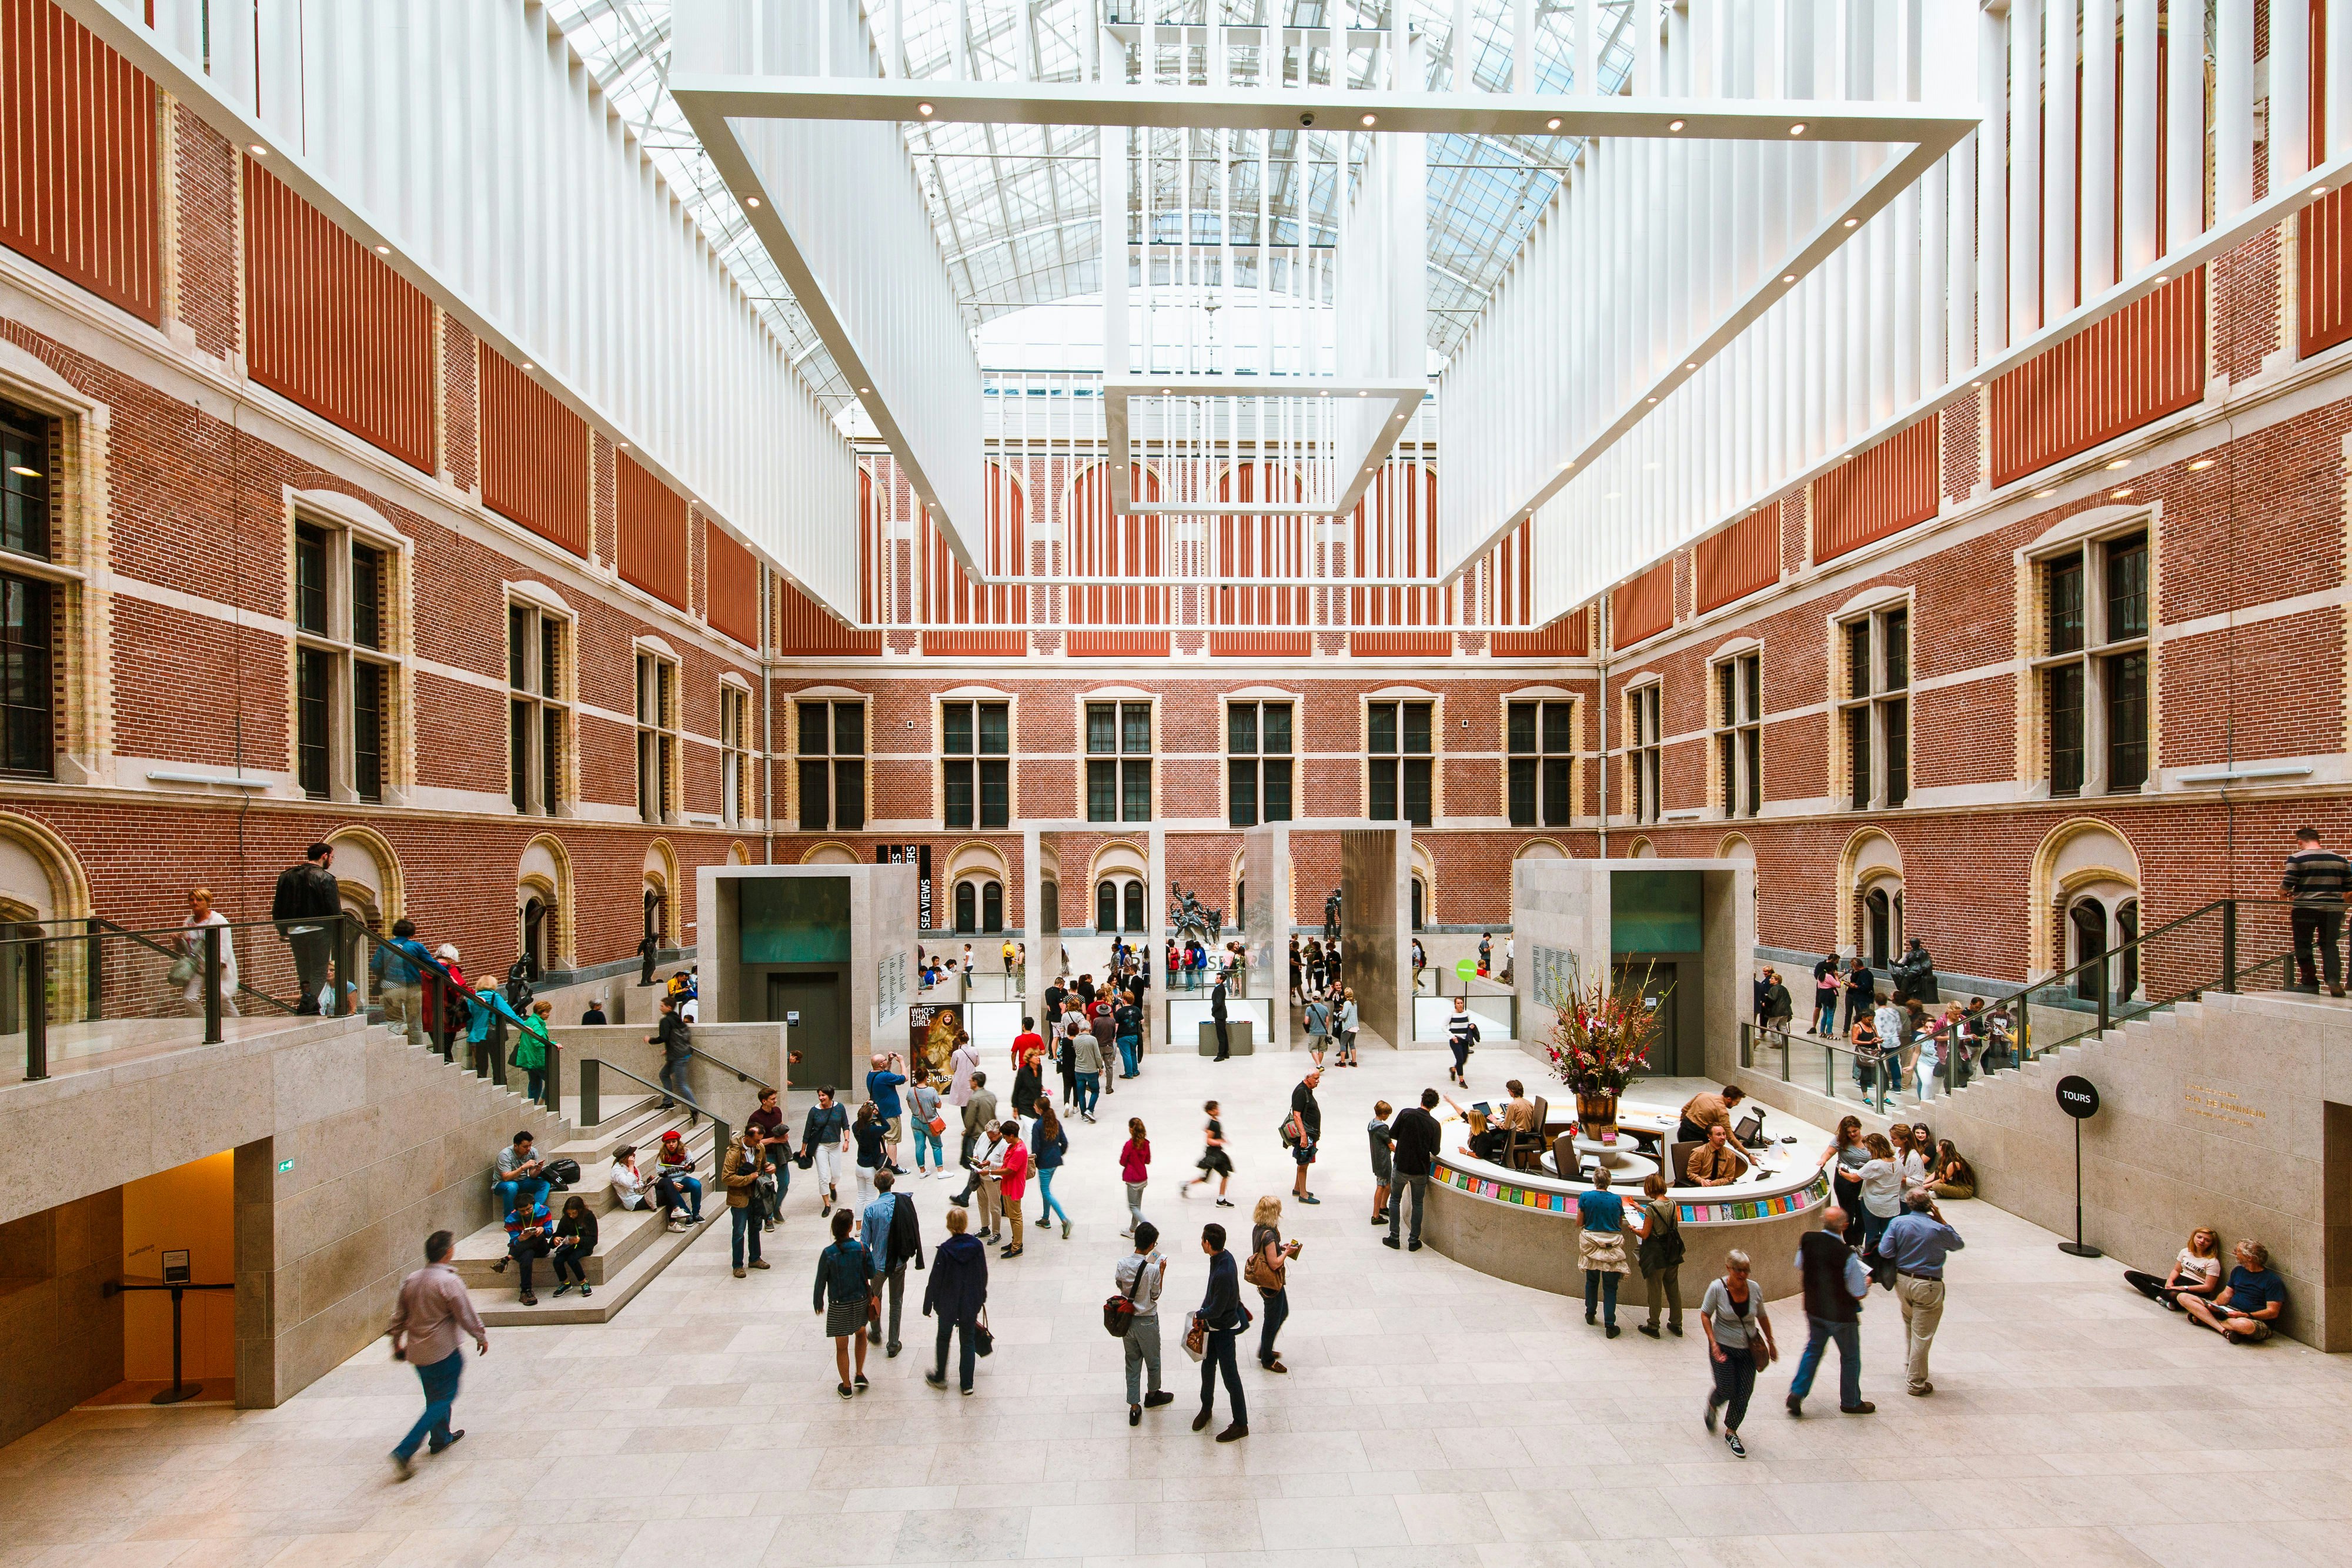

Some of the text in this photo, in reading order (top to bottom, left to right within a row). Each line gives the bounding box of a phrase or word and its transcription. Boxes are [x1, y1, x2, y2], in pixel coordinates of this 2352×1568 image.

[921, 879, 931, 928] SEA VIEWS
[2062, 1090, 2091, 1104] TOURS
[2206, 1099, 2218, 1108] DE
[2186, 1262, 2205, 1273] NOTHING
